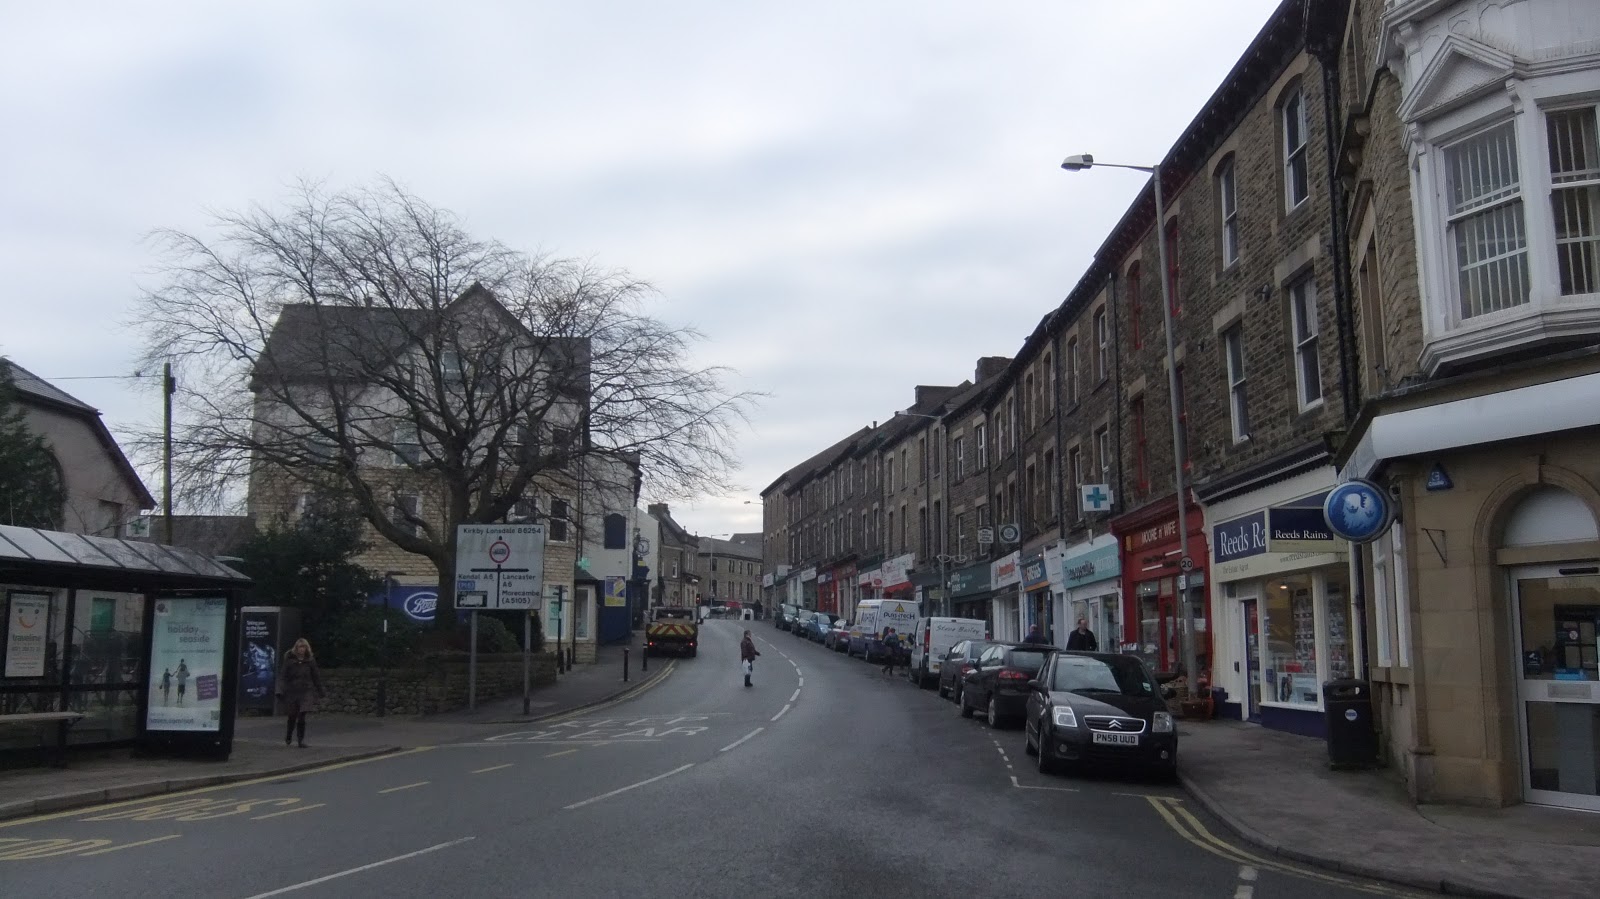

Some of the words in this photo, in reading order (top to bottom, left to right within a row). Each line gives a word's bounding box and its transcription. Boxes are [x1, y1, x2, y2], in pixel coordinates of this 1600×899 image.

[1141, 528, 1157, 544] MOORE
[1164, 521, 1176, 536] WIFE
[1275, 530, 1300, 539] Reeds
[1303, 530, 1328, 539] Rains
[1220, 526, 1249, 556] Reeds
[168, 624, 199, 636] holiday
[12, 634, 41, 642] traveline
[179, 635, 210, 643] seaside
[547, 716, 709, 728] KEEP
[484, 726, 709, 741] CLEAR
[1096, 733, 1118, 742] PN58
[1119, 735, 1136, 744] UUD
[78, 797, 302, 822] BUS
